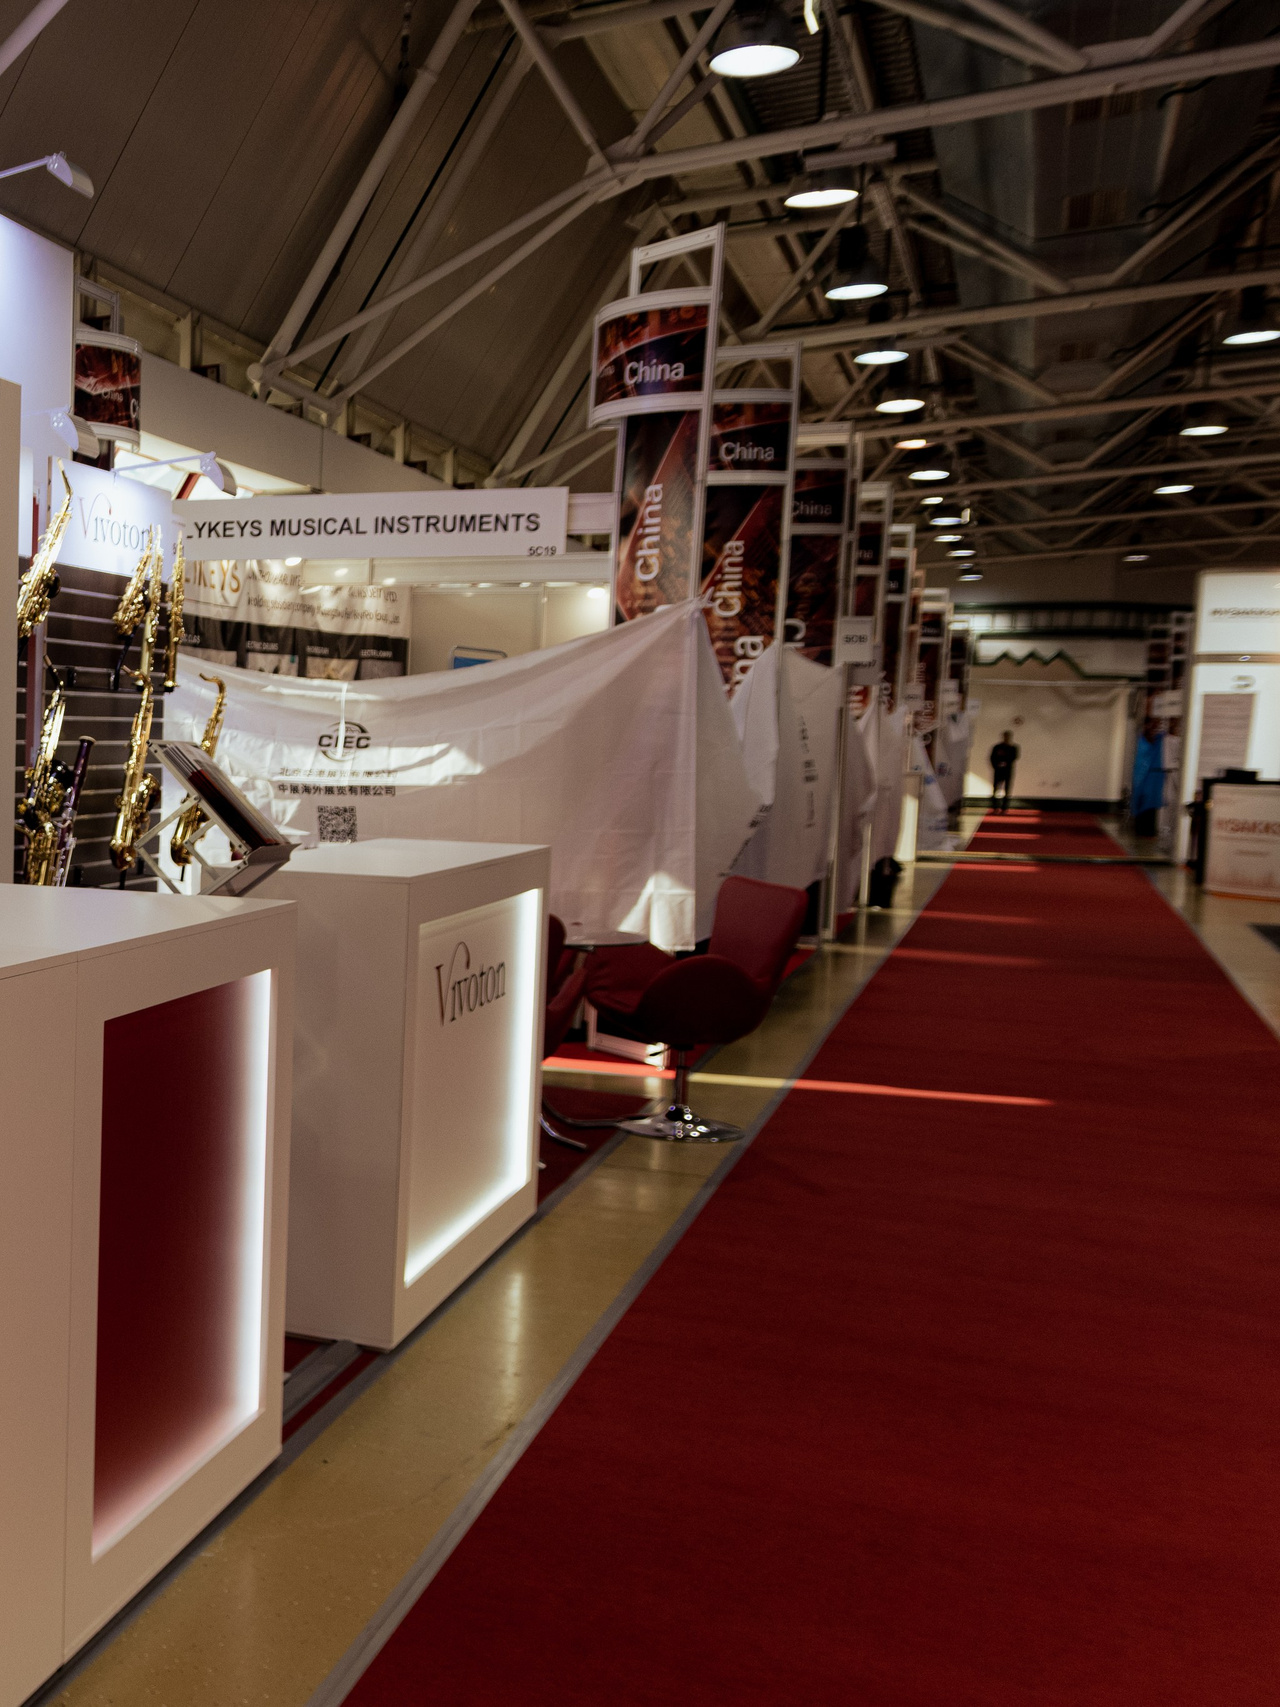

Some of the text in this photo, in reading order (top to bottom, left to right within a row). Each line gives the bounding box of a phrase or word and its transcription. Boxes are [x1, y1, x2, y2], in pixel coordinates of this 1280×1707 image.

[624, 359, 684, 386] China
[721, 441, 774, 462] China
[187, 513, 541, 539] YKEYS MUSICAL INSTRUMENTS
[635, 483, 664, 582] China
[528, 546, 557, 556] 5C19
[714, 539, 744, 618] China
[318, 734, 371, 749] CIEC
[435, 941, 506, 1027] Vivoton
